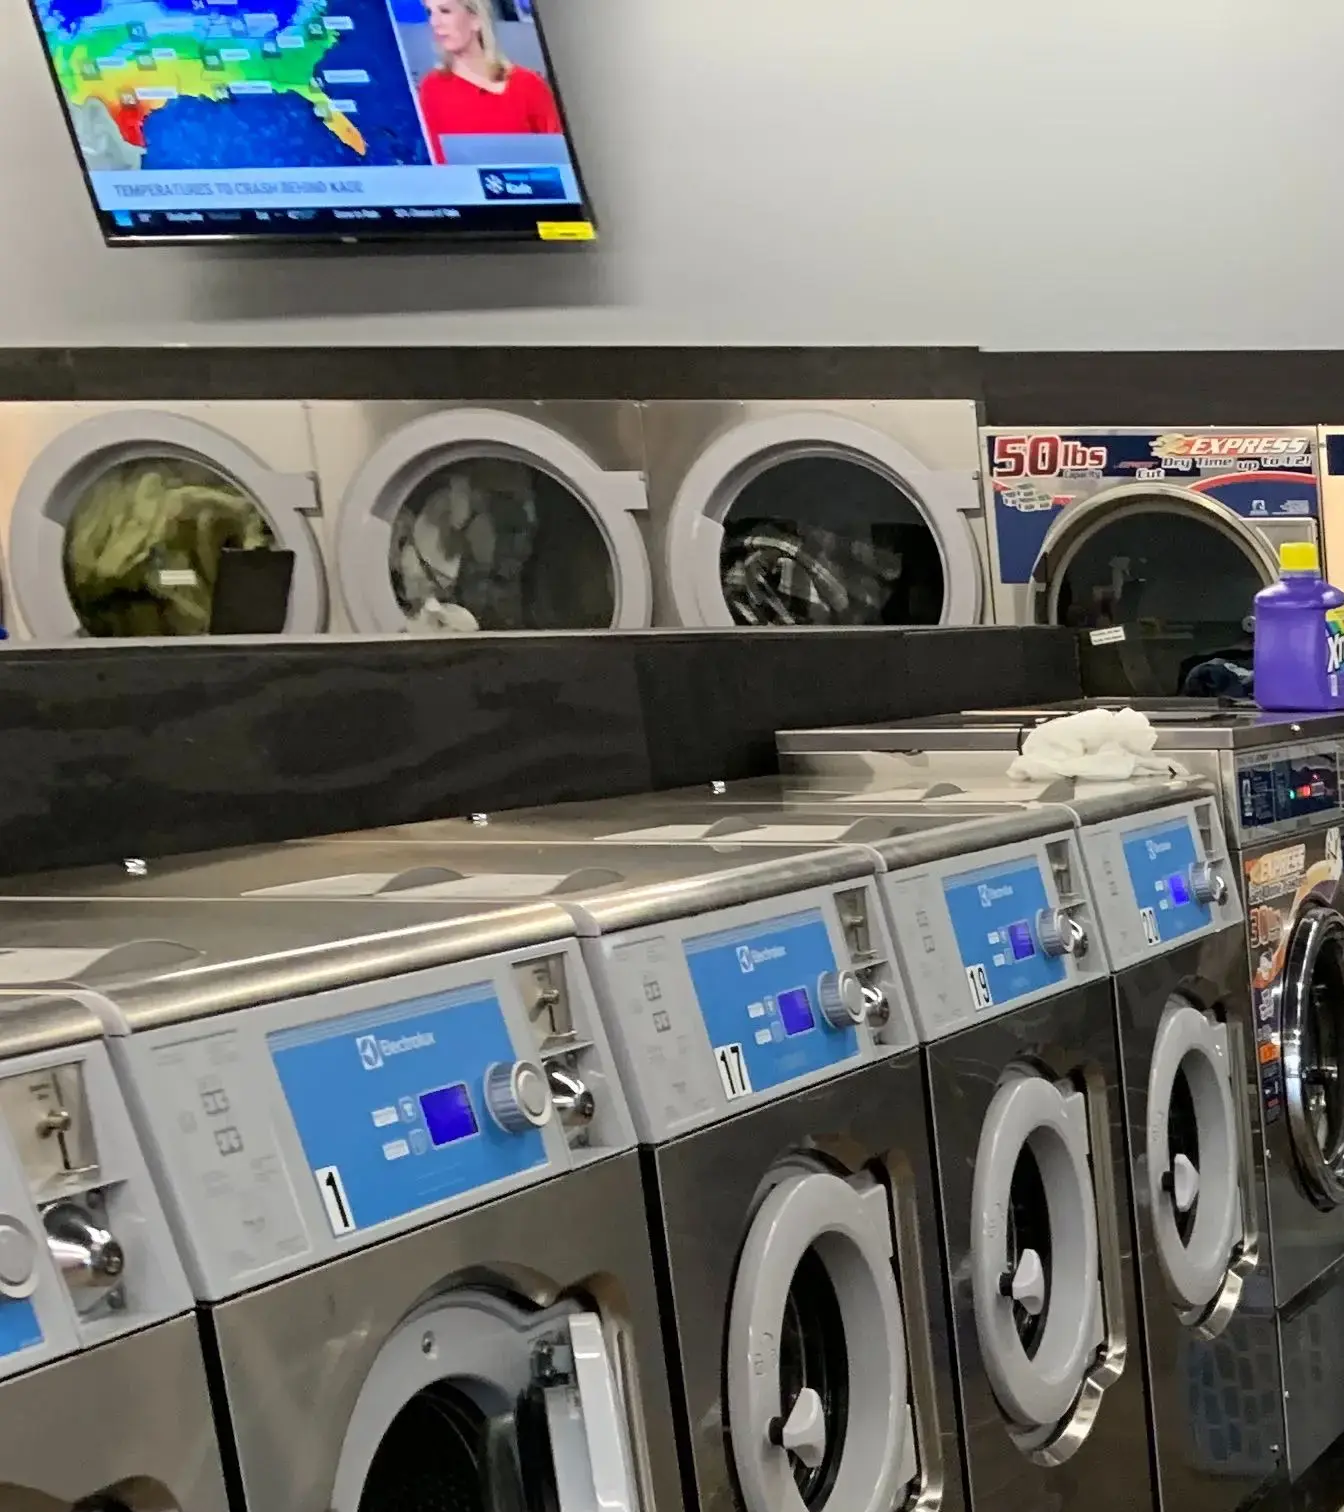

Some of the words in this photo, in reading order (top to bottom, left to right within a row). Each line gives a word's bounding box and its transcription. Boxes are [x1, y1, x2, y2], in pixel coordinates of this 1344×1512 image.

[1190, 437, 1308, 455] EXPRESS
[1163, 457, 1192, 470] Dry
[1237, 460, 1260, 472] up
[970, 966, 991, 1007] 19
[379, 1032, 436, 1057] Electrolux
[720, 1045, 746, 1095] 17
[325, 1171, 350, 1228] 1
